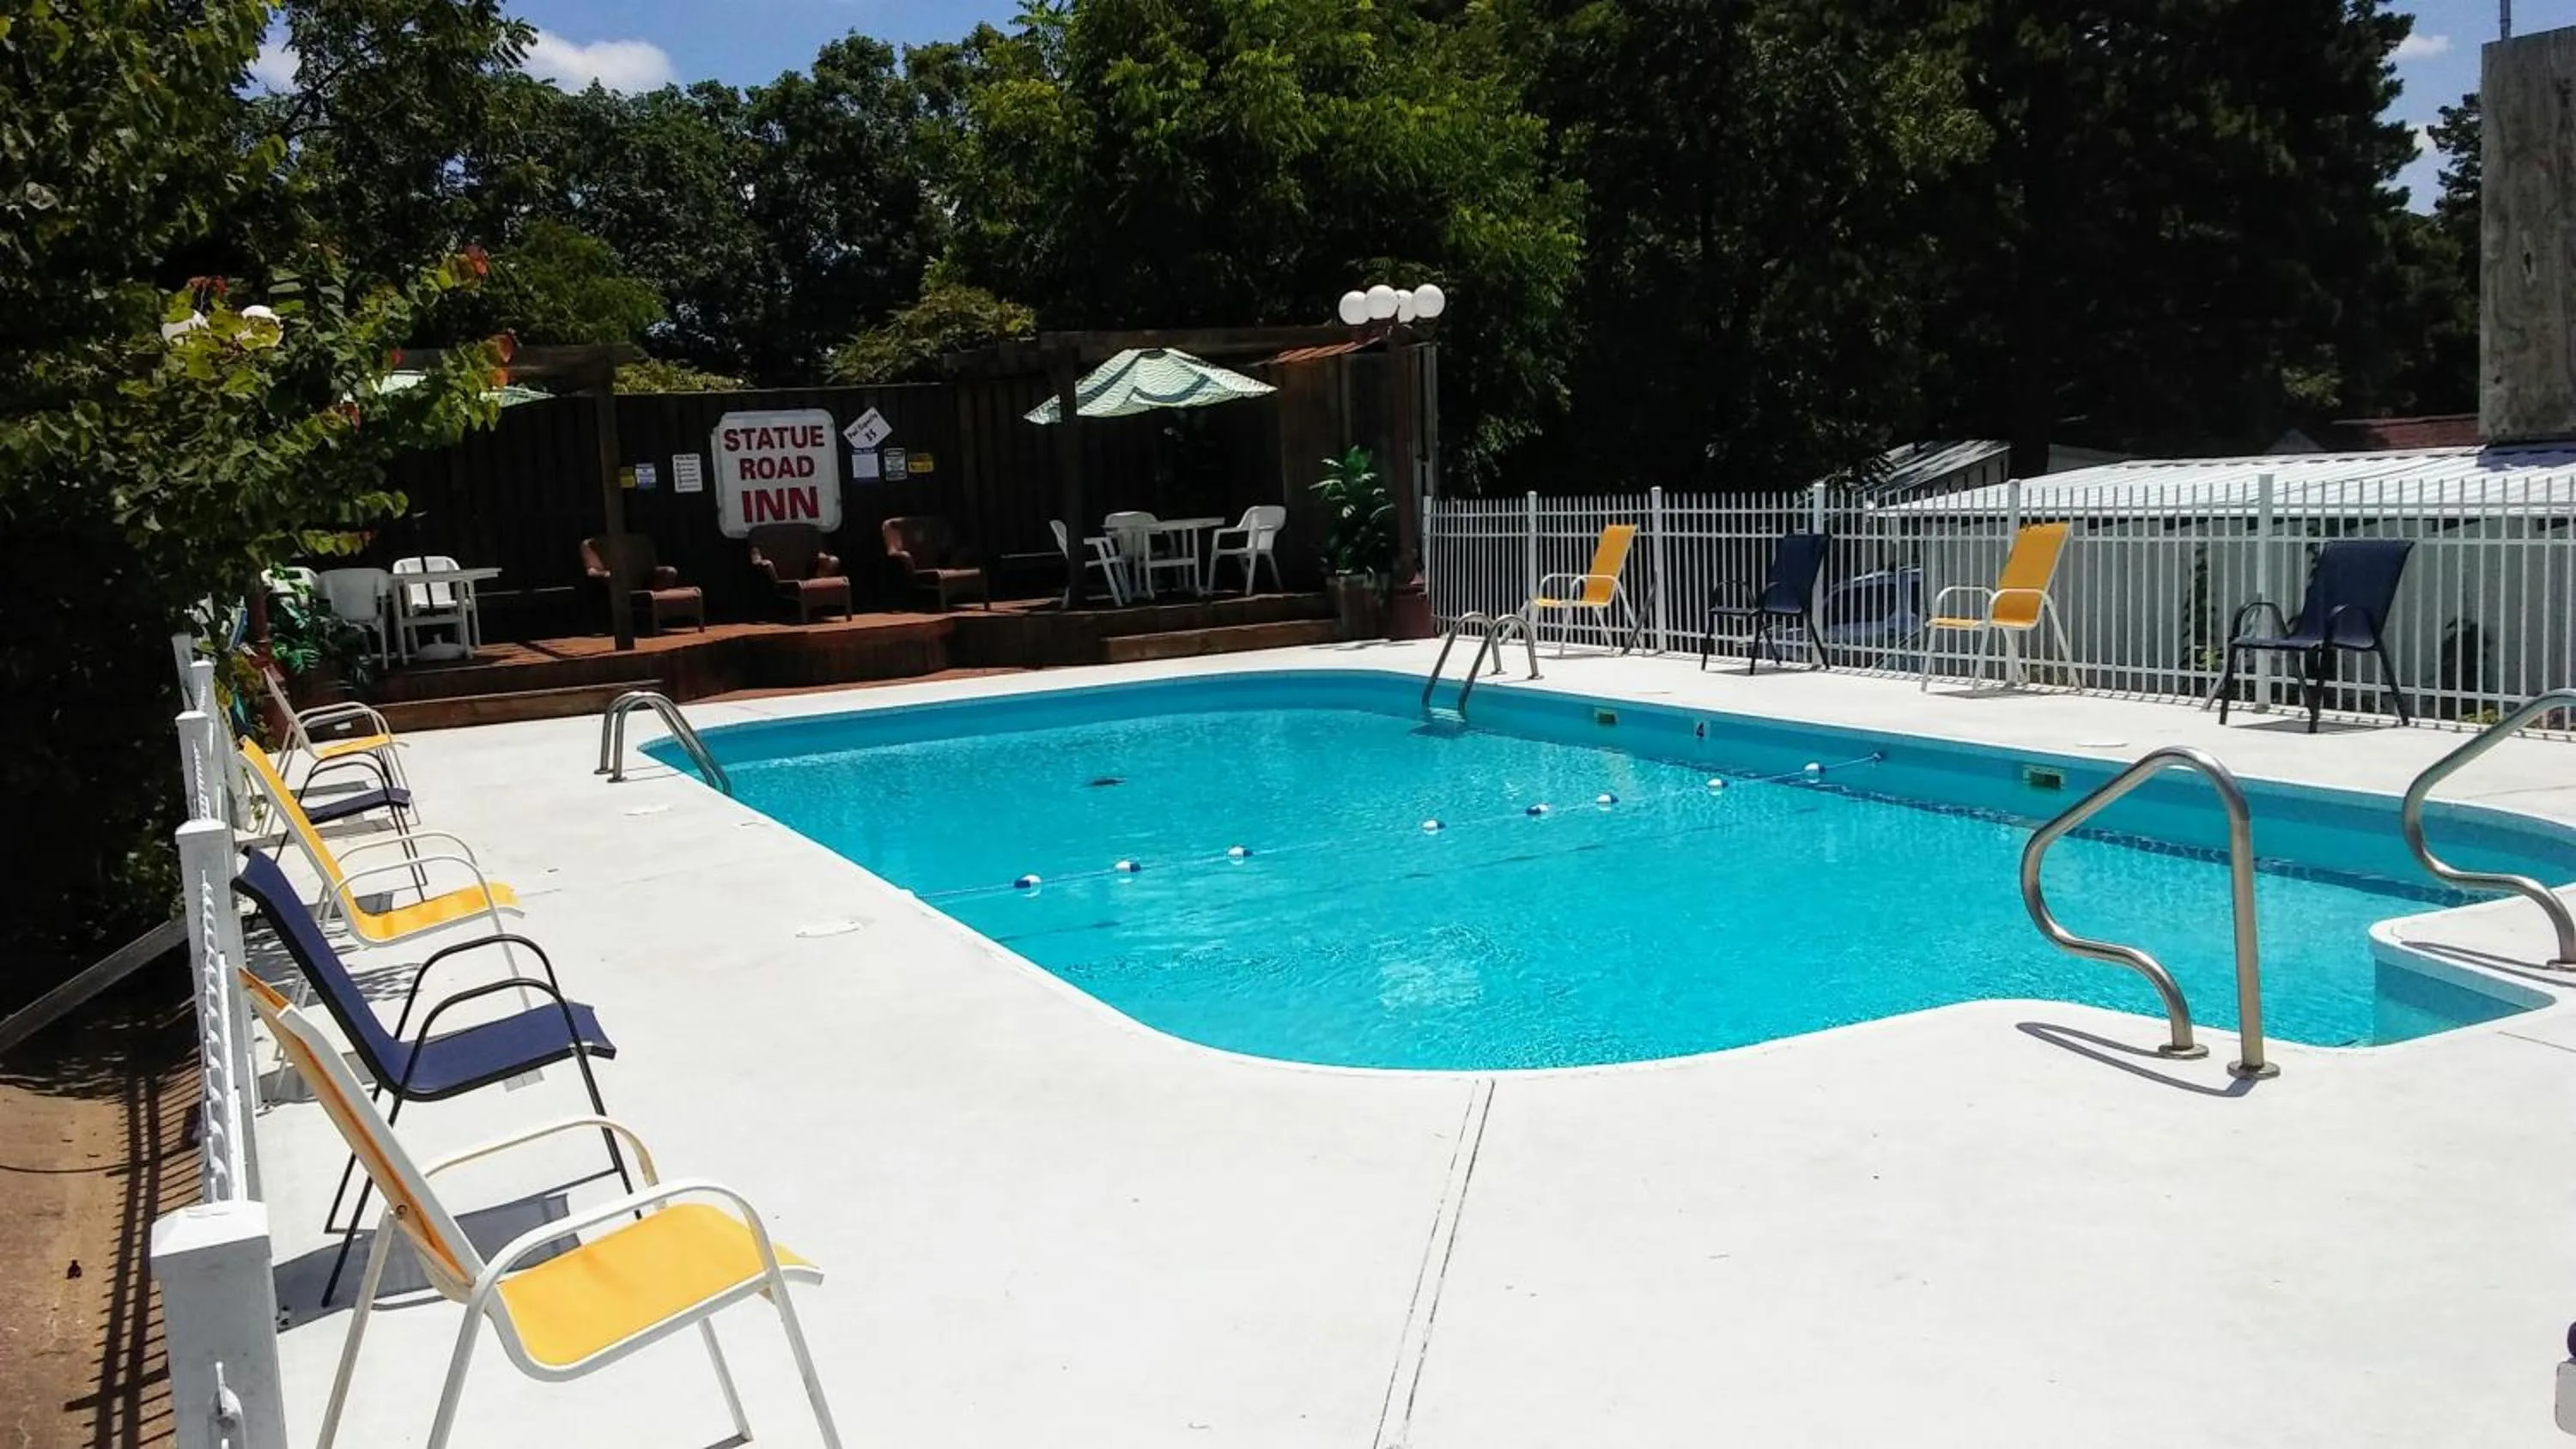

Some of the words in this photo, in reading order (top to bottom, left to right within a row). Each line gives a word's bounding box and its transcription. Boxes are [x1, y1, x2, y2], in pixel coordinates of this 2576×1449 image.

[724, 425, 825, 452] STATUE
[739, 455, 815, 480] ROAD
[742, 486, 820, 524] INN
